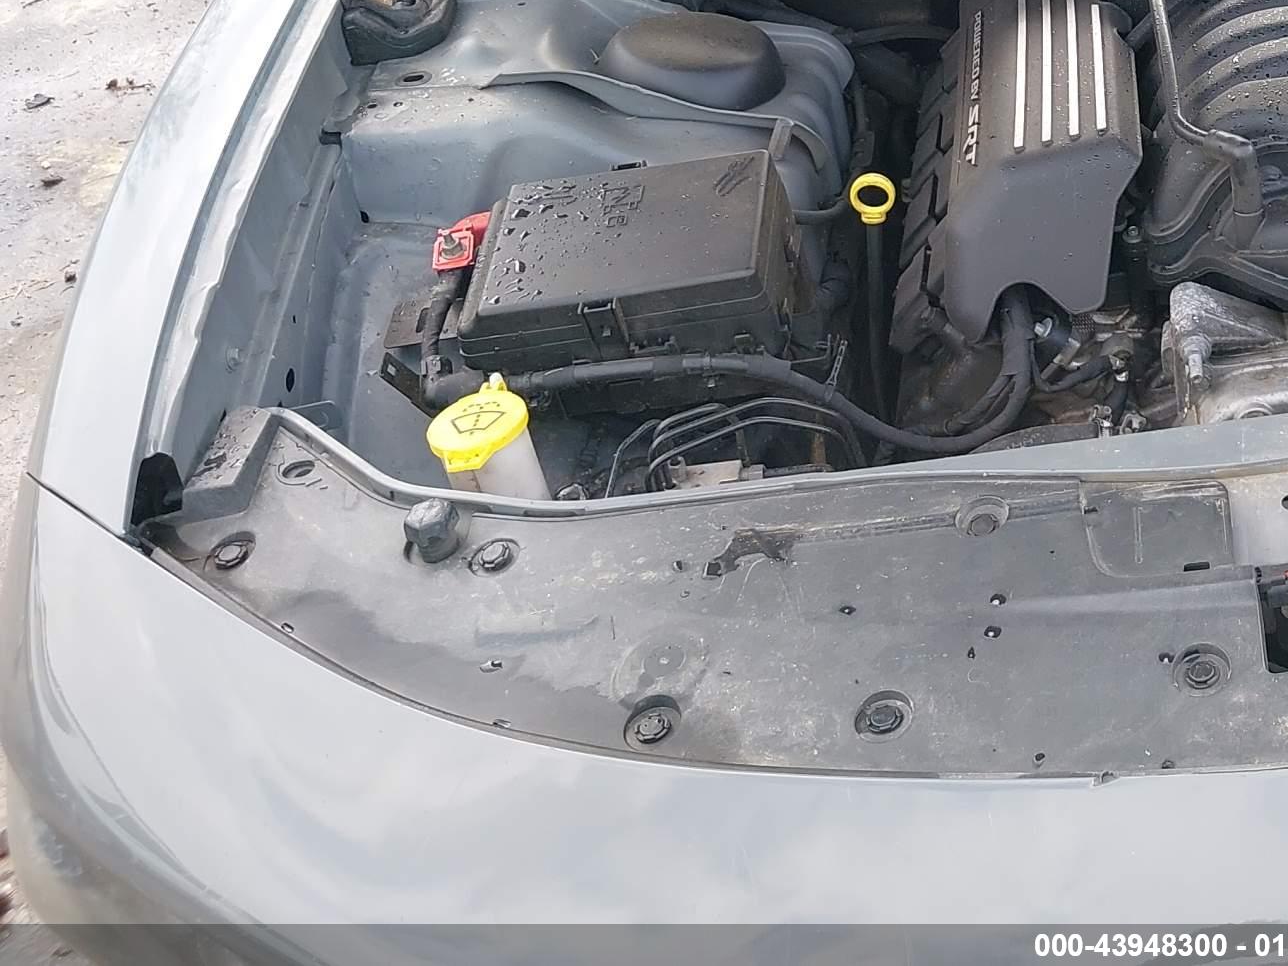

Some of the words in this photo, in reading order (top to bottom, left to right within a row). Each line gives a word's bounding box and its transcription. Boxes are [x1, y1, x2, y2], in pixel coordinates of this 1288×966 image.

[972, 10, 982, 80] POWERED
[969, 80, 979, 101] BY
[963, 104, 980, 165] SRT
